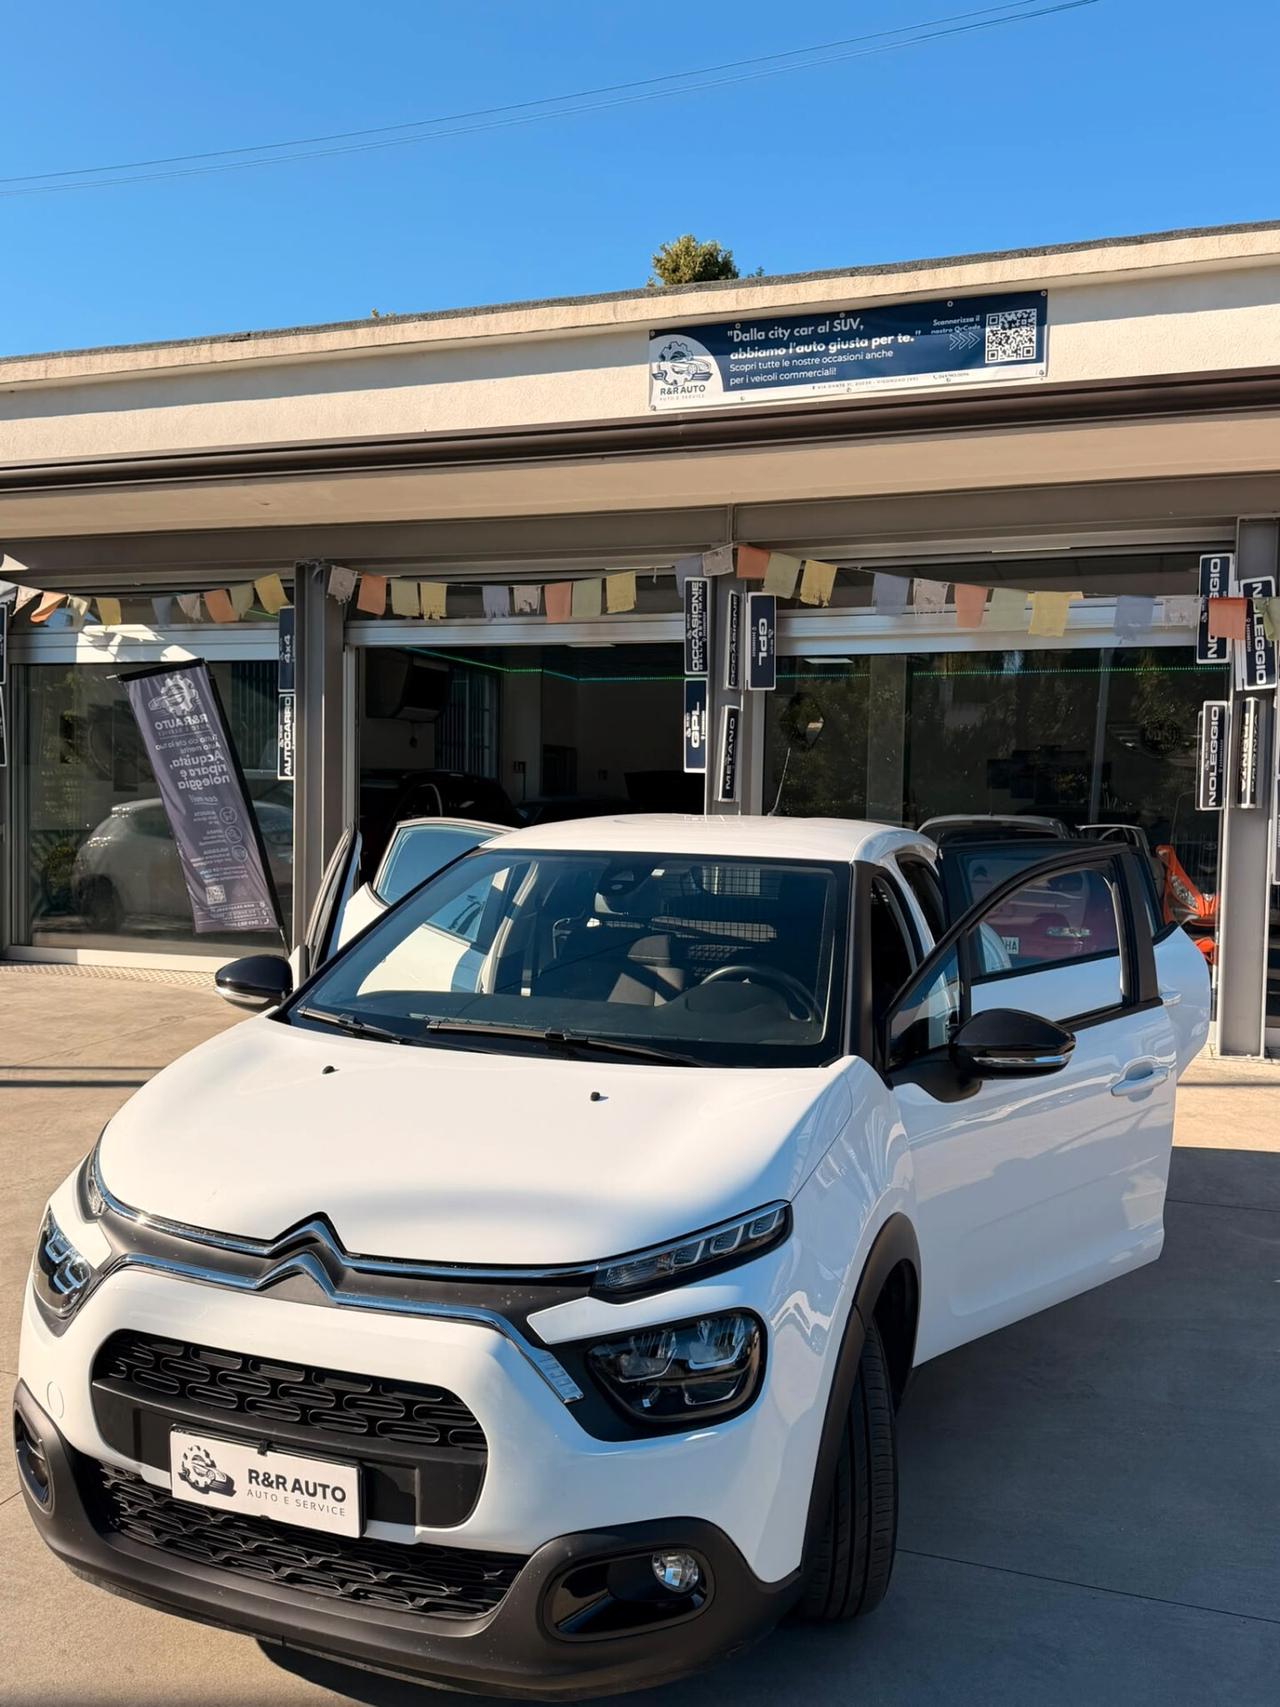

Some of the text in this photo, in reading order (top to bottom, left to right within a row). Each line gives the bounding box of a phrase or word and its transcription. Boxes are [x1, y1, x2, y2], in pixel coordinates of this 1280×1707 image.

[727, 317, 864, 343] "Dalla city car al SUV,
[730, 345, 786, 360] abbiamo
[788, 340, 825, 354] l'auto
[828, 335, 868, 354] giusta
[871, 334, 894, 348] per
[729, 348, 894, 374] Scopri tutte le nostre occasioni anche
[729, 376, 745, 387] per
[750, 371, 779, 383] veicoli
[780, 367, 837, 382] commerciali!
[660, 384, 706, 396] R&R AUTO
[691, 582, 699, 672] OCCASIONE
[729, 595, 739, 686] OCCASIONE
[758, 617, 768, 667] GPL
[283, 633, 291, 665] 4x4
[283, 696, 292, 777] AUTOCARRO
[691, 701, 700, 748] GPL
[725, 717, 736, 790] METANO
[1208, 706, 1220, 807] NOLEGGIO
[246, 1488, 346, 1517] AUTO E SERVICE
[247, 1467, 347, 1504] R&R AUTO
